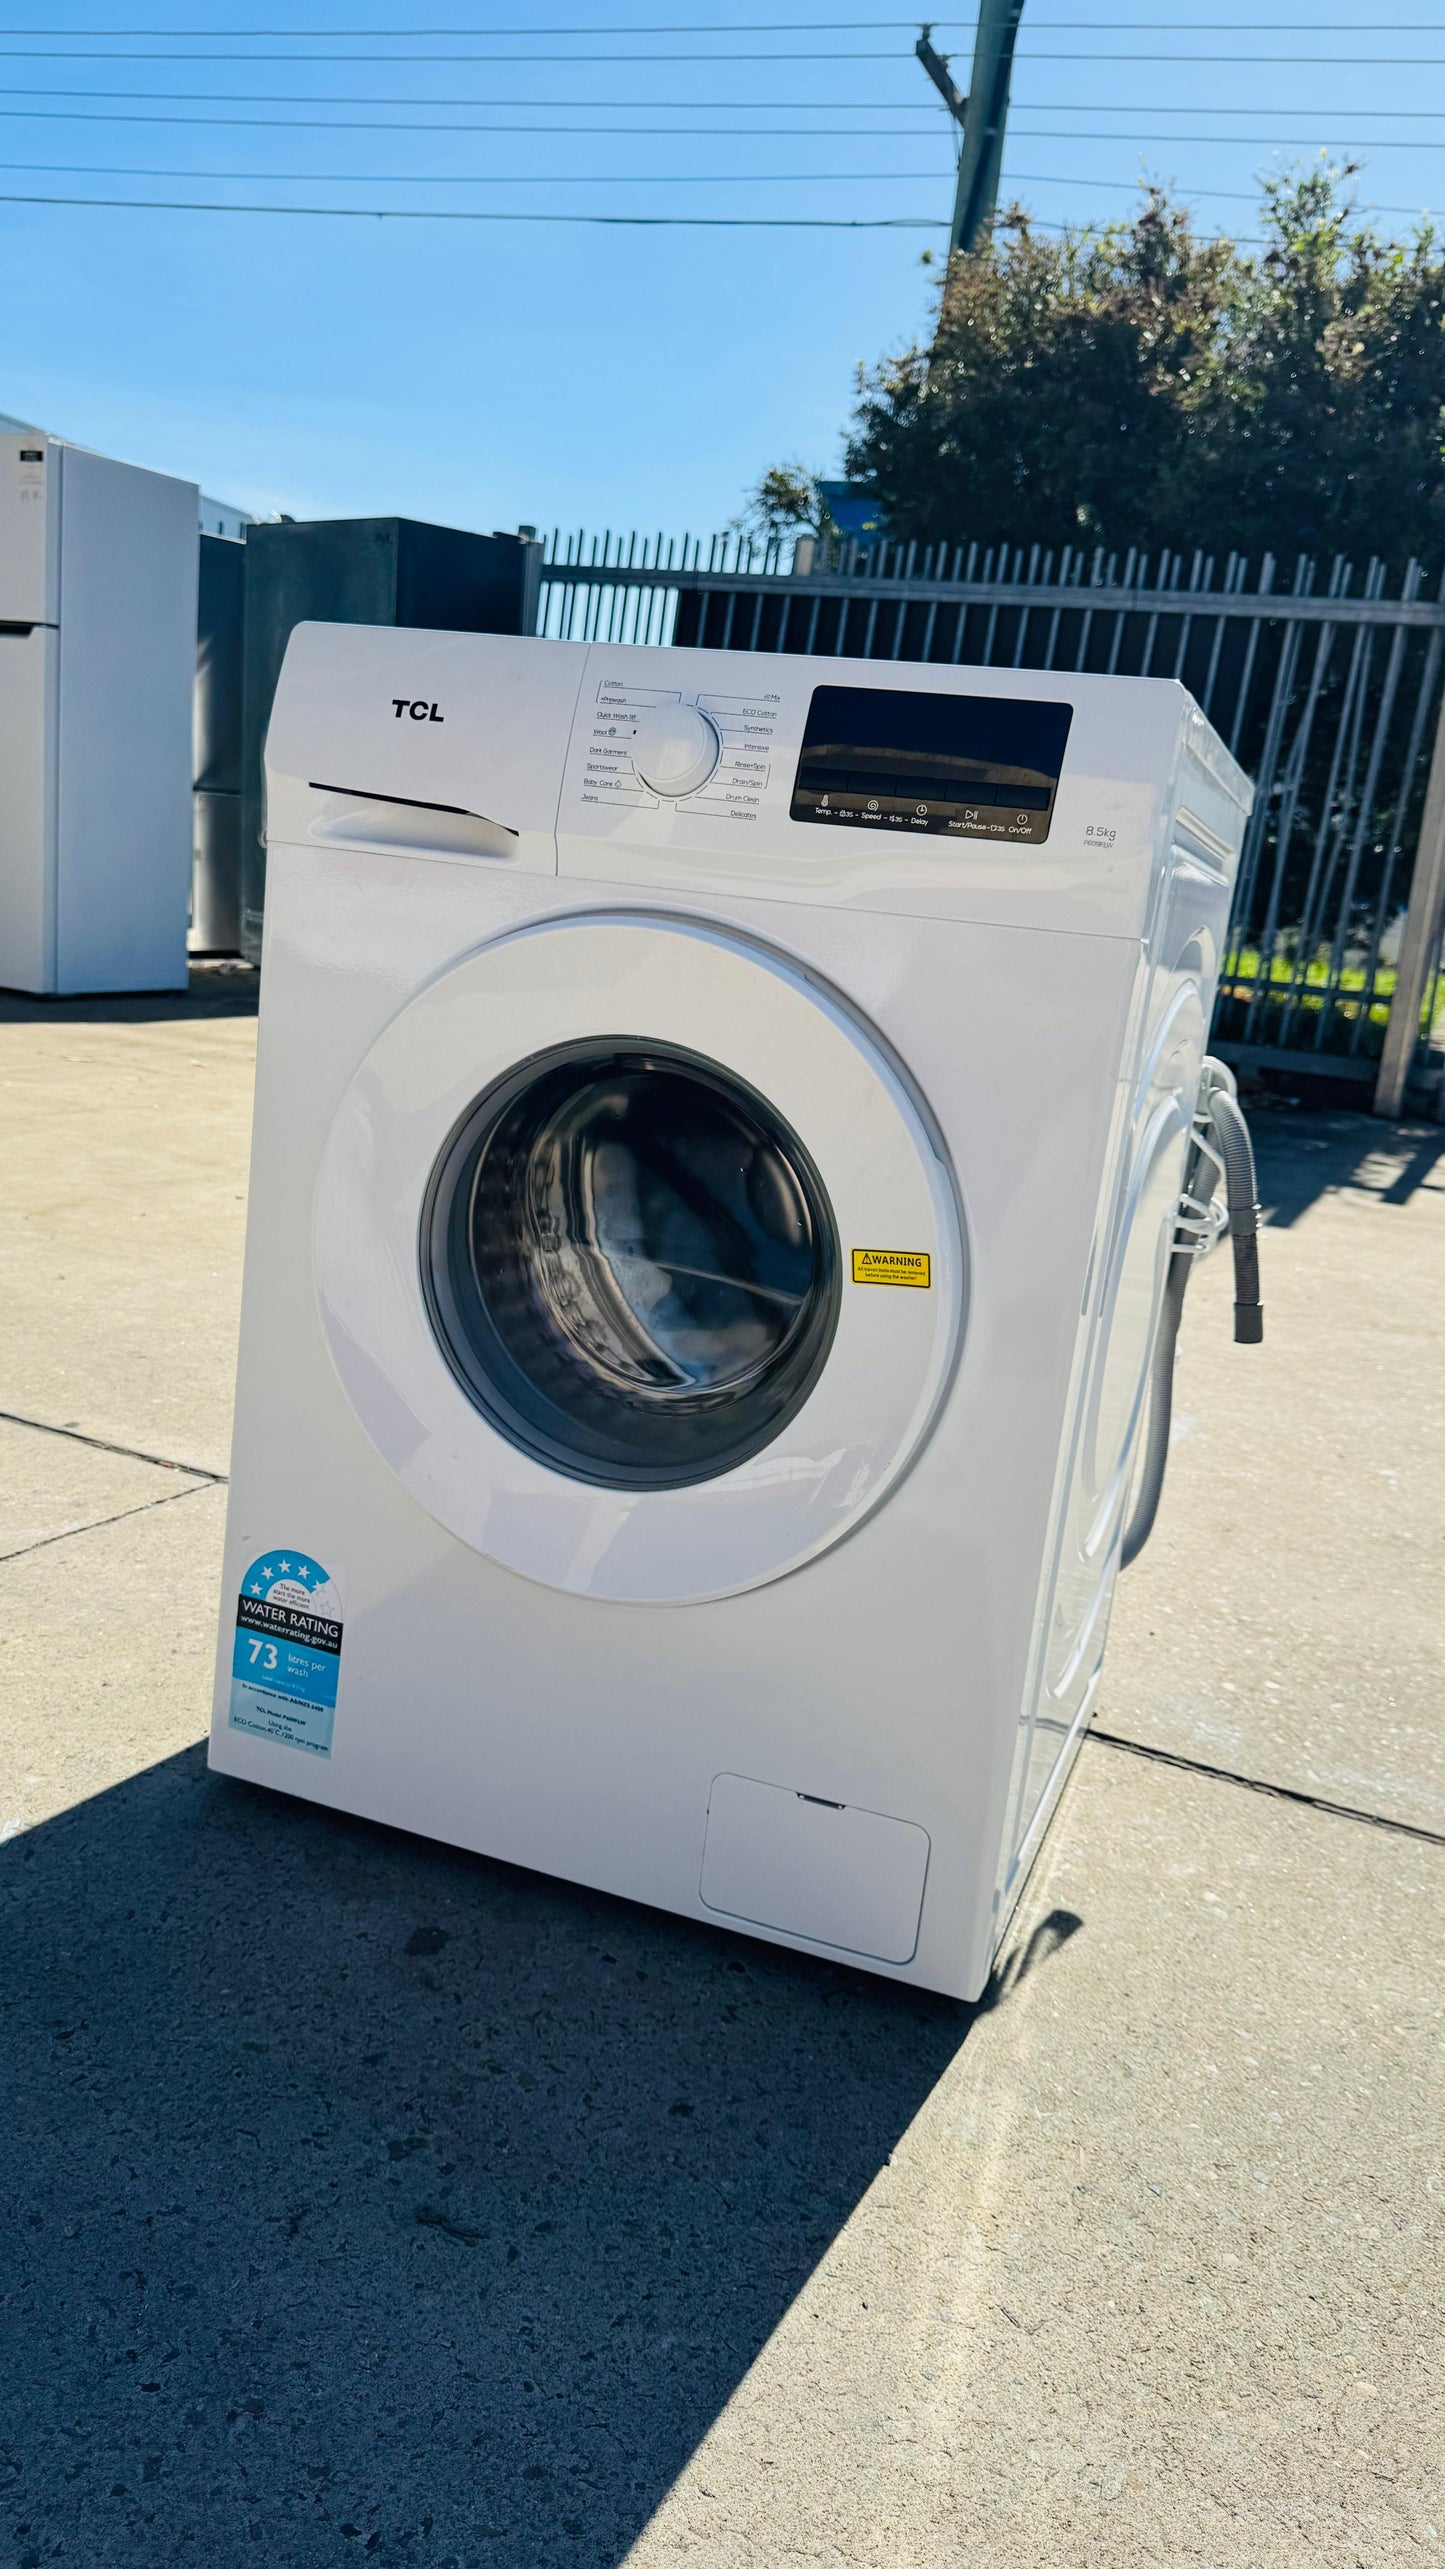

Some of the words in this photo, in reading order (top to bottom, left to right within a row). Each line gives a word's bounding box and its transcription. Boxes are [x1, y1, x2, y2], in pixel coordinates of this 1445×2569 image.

[392, 699, 444, 722] TCL
[744, 725, 774, 734] Synthetics
[586, 763, 618, 772] Sportswear
[735, 761, 766, 770] Rinse+Spin
[732, 778, 763, 787] Drain/Spin
[730, 810, 757, 819] Delicates
[815, 808, 832, 816] Temp.
[861, 812, 882, 820] Speed
[911, 818, 928, 826] Delay
[1008, 826, 1032, 835] On/Off
[1086, 826, 1116, 842] 8.5kg
[872, 1255, 922, 1268] WARNING
[273, 1588, 286, 1597] stars
[286, 1592, 296, 1600] the
[296, 1596, 310, 1604] more
[280, 1583, 290, 1592] The
[290, 1587, 306, 1596] more
[273, 1595, 288, 1604] water
[242, 1600, 286, 1624] WATER
[290, 1613, 339, 1638] RATING
[240, 1615, 338, 1649] www.waterrating.gov.au
[248, 1638, 278, 1670] 73
[288, 1652, 309, 1668] litres
[311, 1662, 326, 1672] per
[287, 1666, 309, 1678] wash
[248, 1686, 276, 1698] accordance
[234, 1716, 247, 1726] ECO
[294, 1736, 306, 1744] rpm
[268, 1720, 282, 1730] Using
[283, 1724, 292, 1732] the
